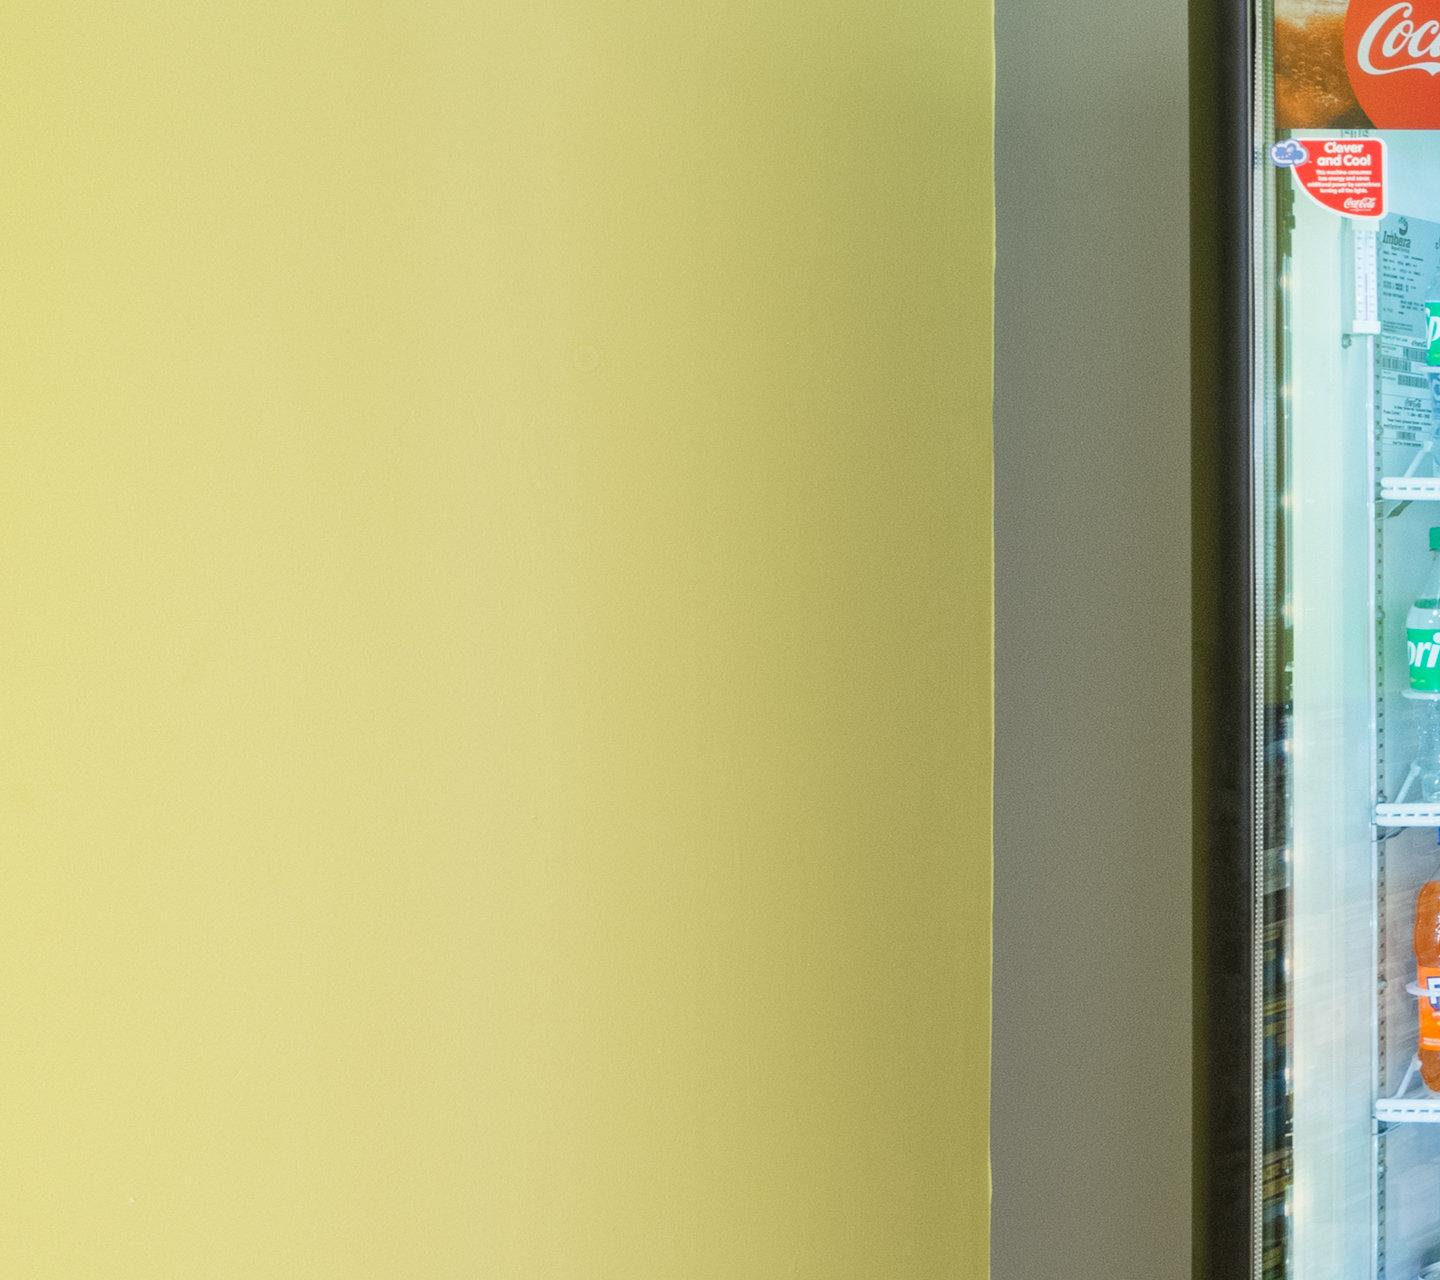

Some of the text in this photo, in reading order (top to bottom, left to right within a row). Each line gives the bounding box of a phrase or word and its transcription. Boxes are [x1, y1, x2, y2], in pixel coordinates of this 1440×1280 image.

[1324, 142, 1364, 154] Clever
[1317, 155, 1371, 166] and Cool
